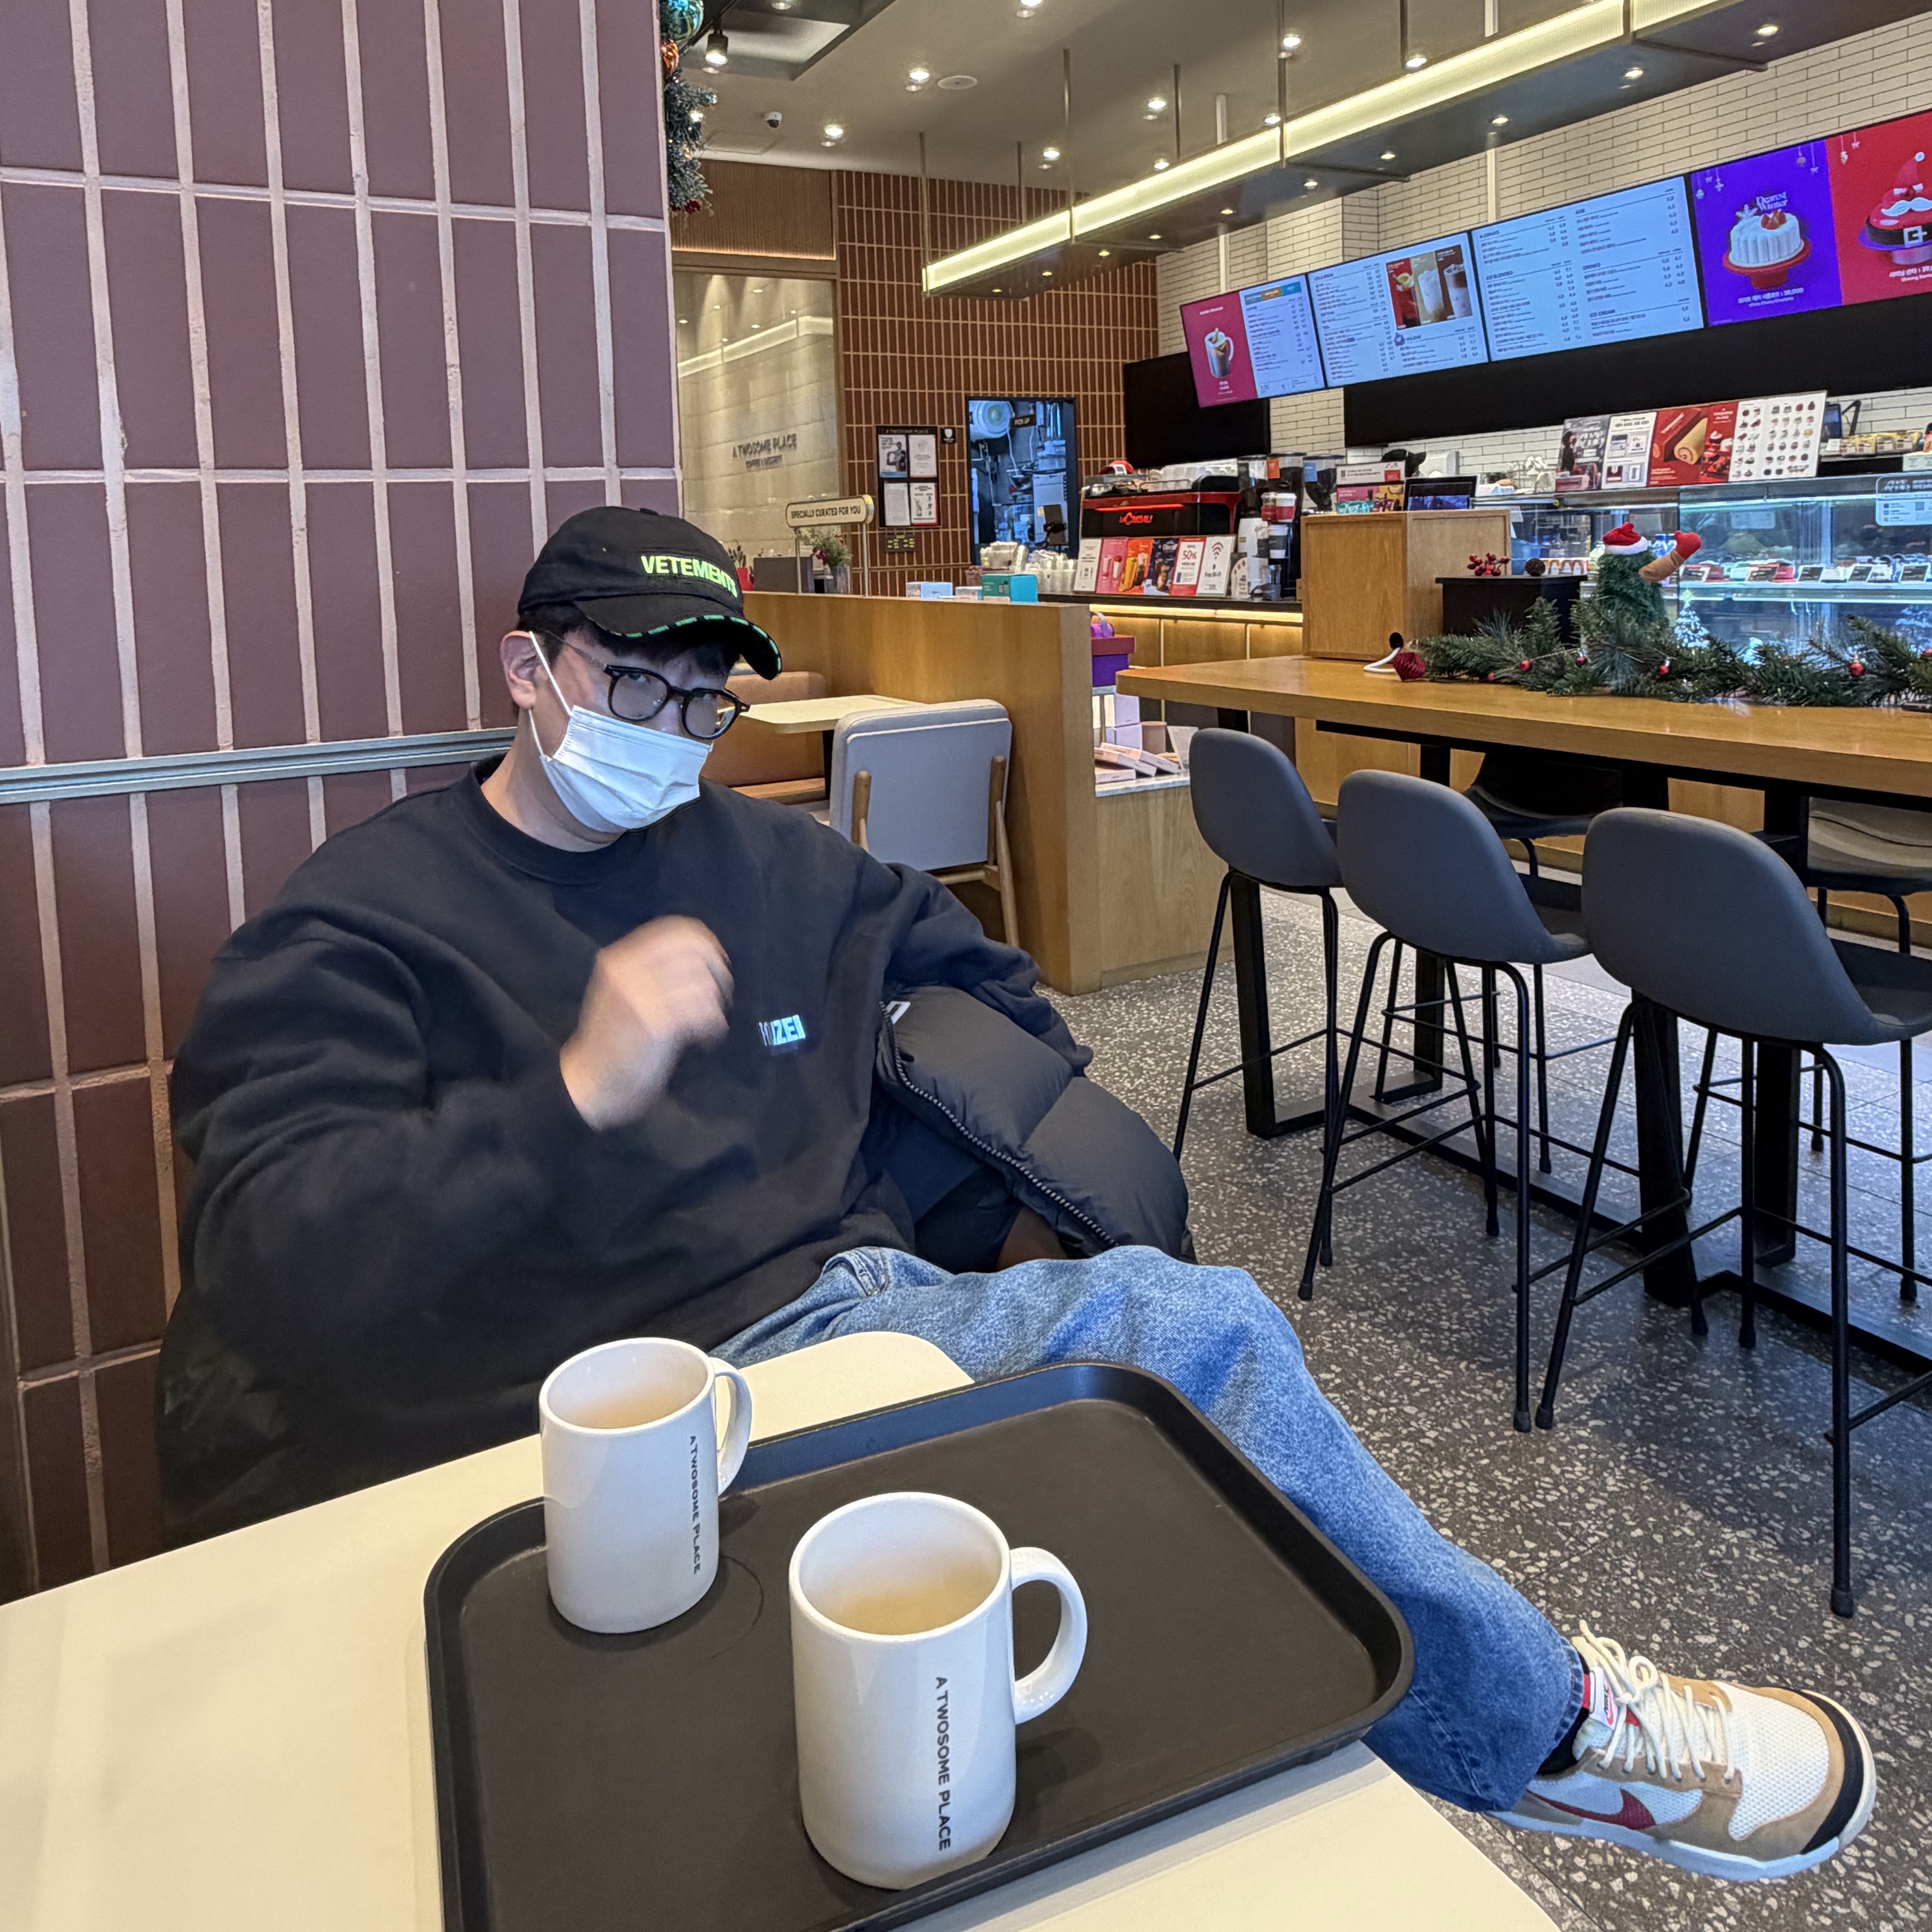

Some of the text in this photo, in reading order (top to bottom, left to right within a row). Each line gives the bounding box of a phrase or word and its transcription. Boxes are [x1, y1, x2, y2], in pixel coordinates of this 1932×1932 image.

[791, 505, 861, 519] SPECIALLY CURATED FOR YOU
[641, 556, 738, 598] VETEMENTS
[690, 1435, 701, 1575] A TWOSOME PLACE
[936, 1677, 951, 1851] A TWOSOME PLACE
